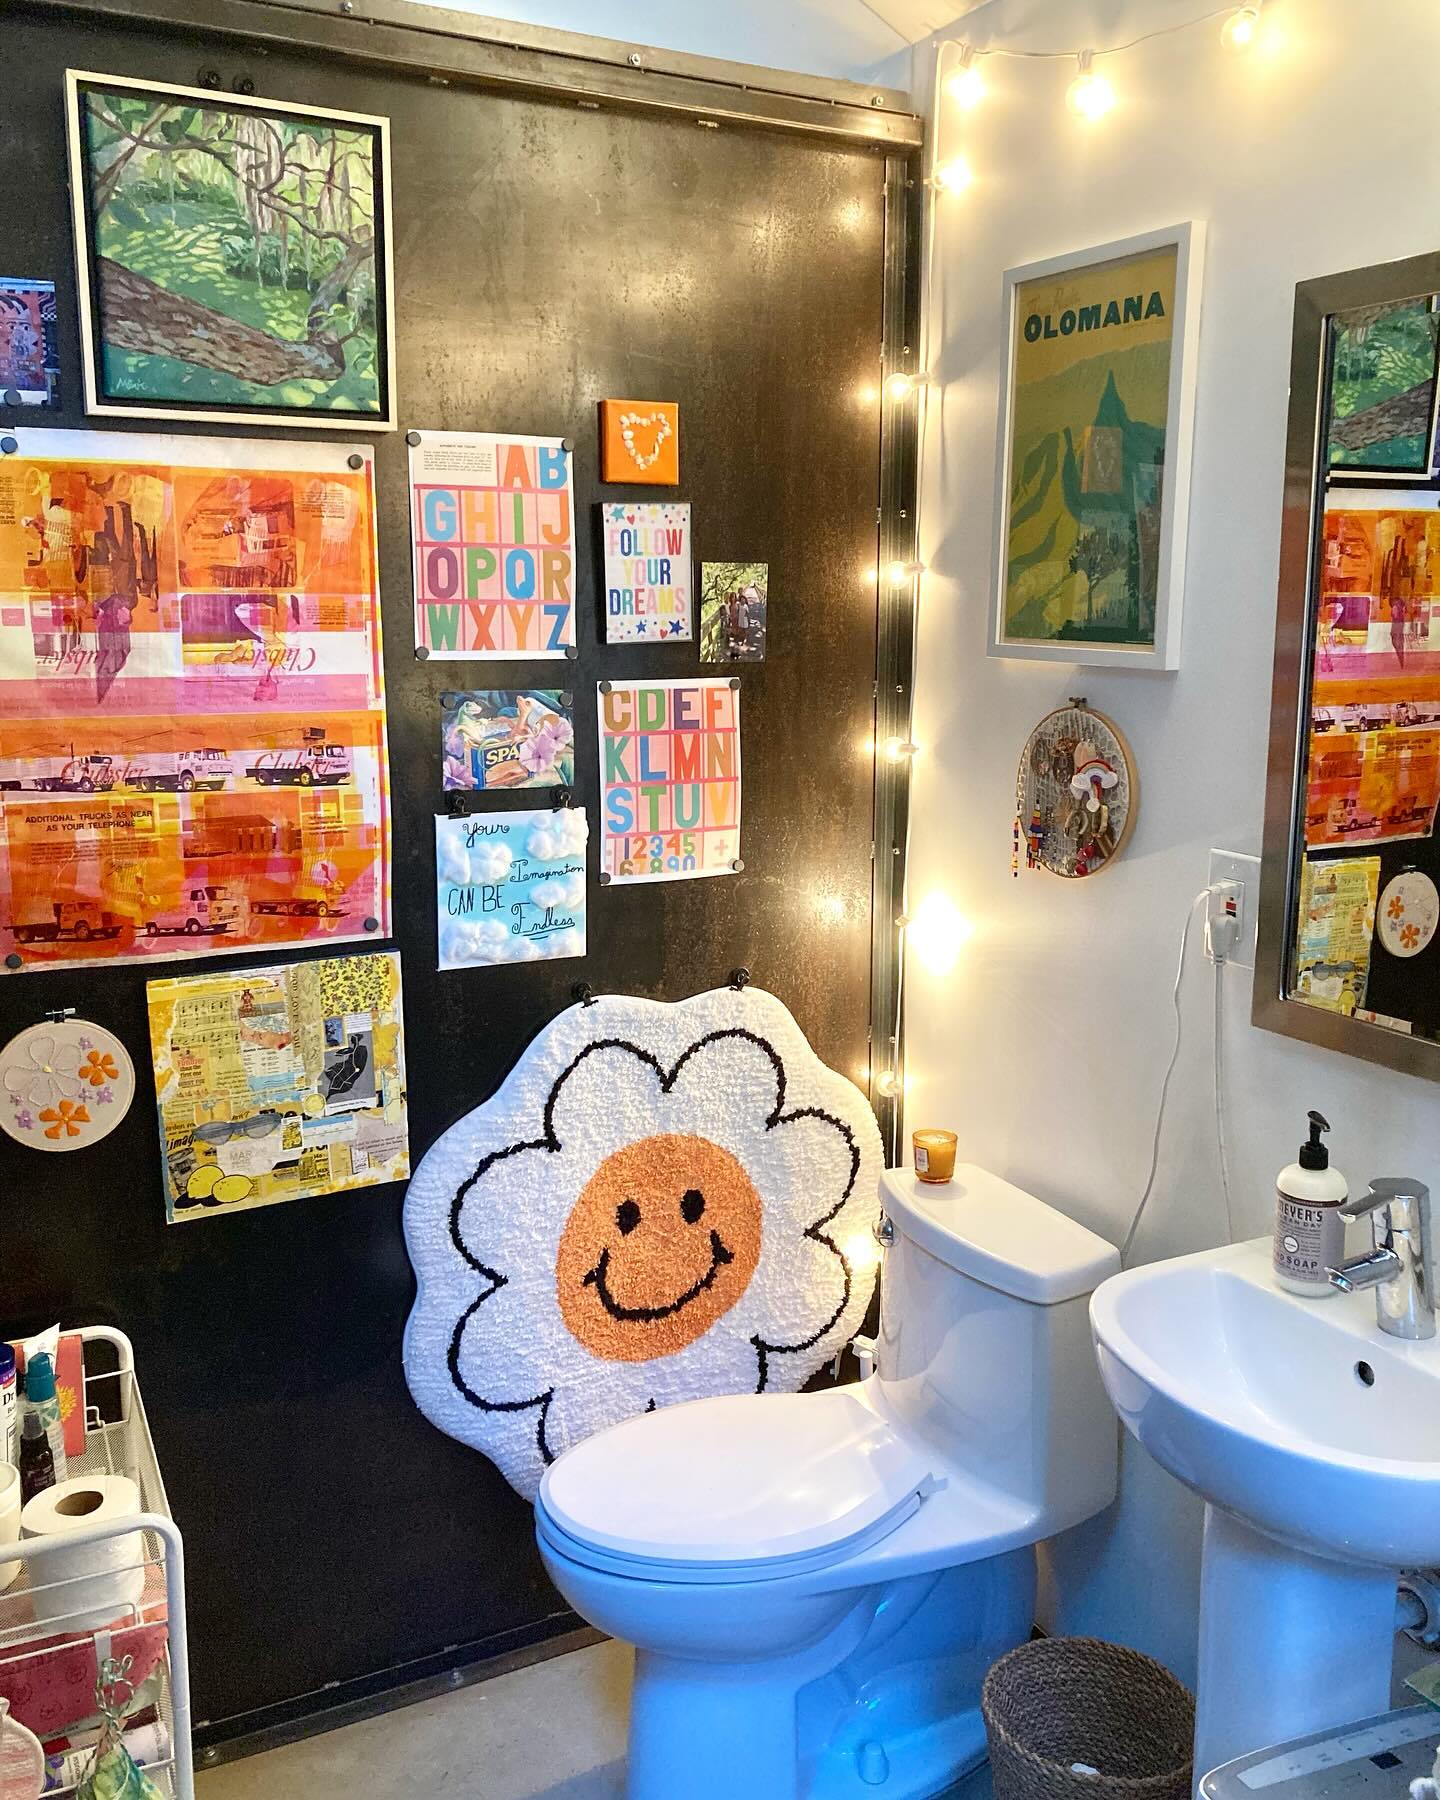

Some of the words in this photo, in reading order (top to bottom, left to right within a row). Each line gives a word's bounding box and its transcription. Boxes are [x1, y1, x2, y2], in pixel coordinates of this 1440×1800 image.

[1024, 291, 1165, 343] OLOMANA
[609, 528, 683, 557] FOLLOW
[623, 558, 671, 585] YOUR
[609, 588, 685, 616] DREAMS
[486, 744, 520, 765] SPA
[25, 814, 75, 824] ADDITIONAL
[79, 812, 112, 821] TRUCKS
[116, 811, 128, 819] AS
[130, 810, 153, 818] NEAR
[46, 824, 58, 832] AS
[62, 823, 84, 831] YOUR
[88, 820, 135, 829] TELEPHONE
[448, 887, 474, 915] CAN
[482, 884, 505, 912] BE
[511, 903, 575, 935] Endless
[1286, 1255, 1318, 1270] SOAP
